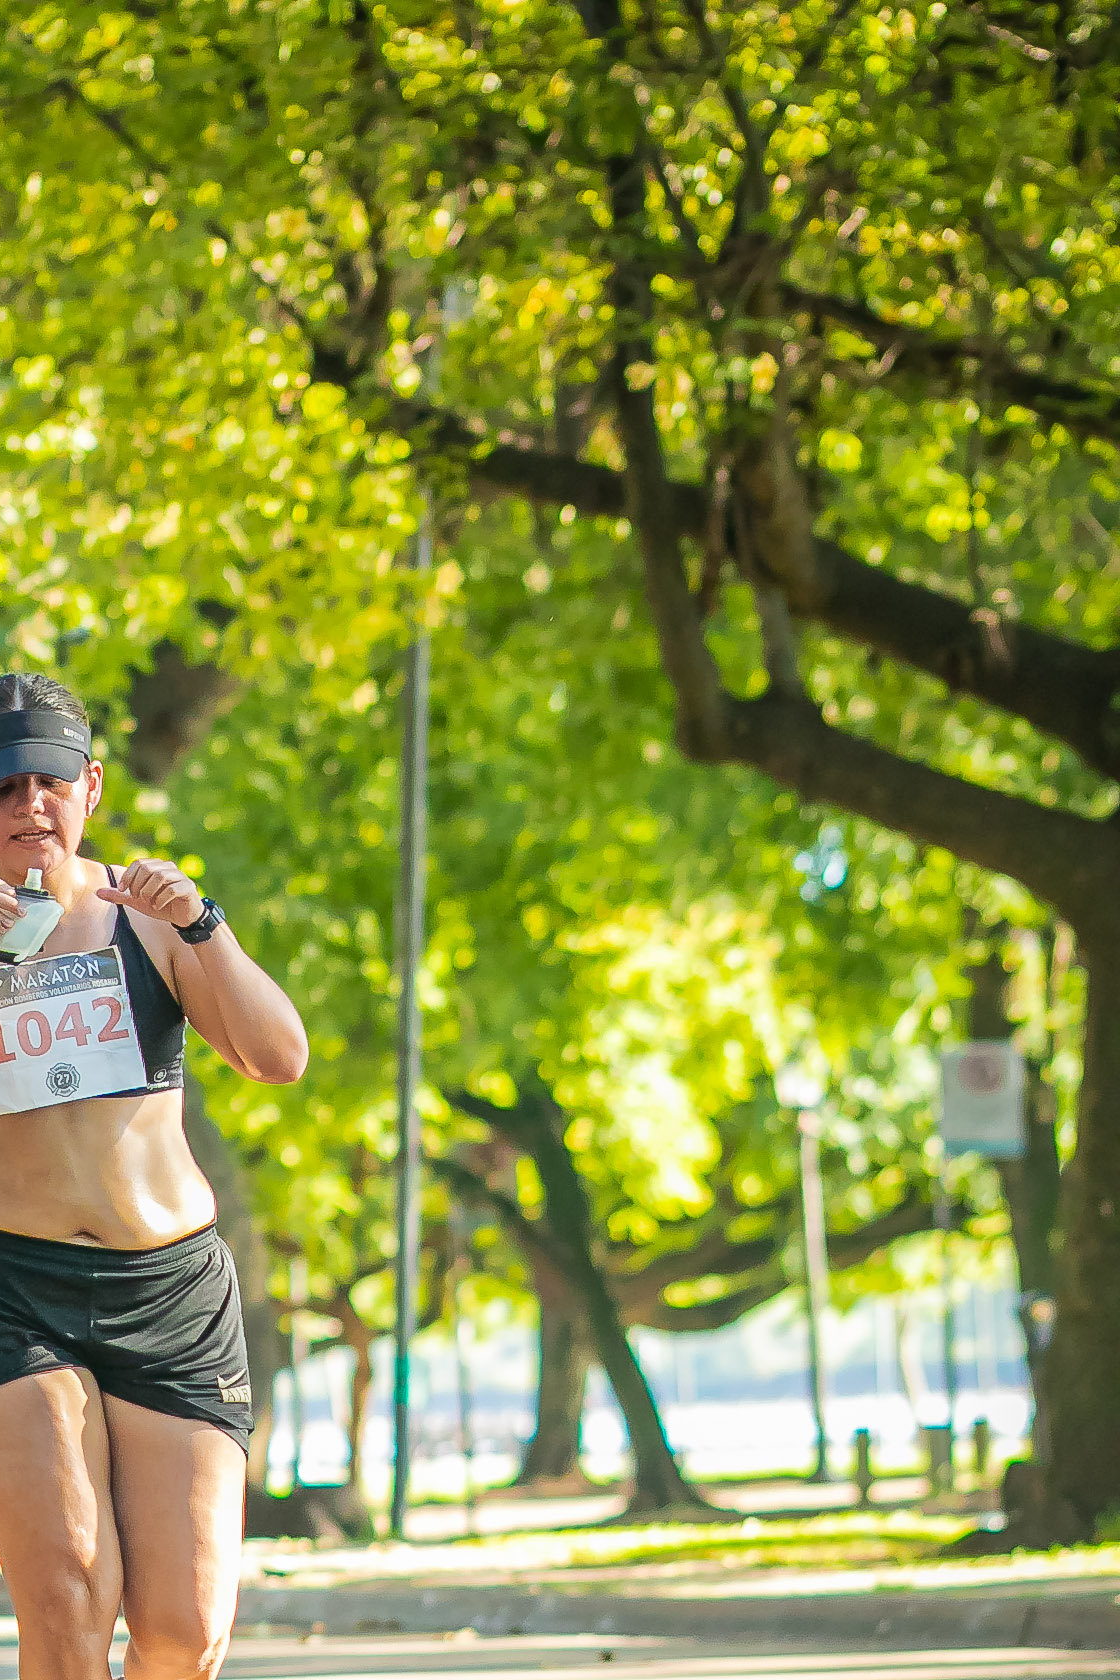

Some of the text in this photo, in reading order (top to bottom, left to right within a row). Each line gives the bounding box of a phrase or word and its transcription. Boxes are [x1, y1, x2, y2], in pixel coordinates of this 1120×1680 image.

[11, 958, 101, 993] MARATÓN
[14, 990, 49, 1004] BOMBEROS
[49, 983, 92, 998] VOLUNTARIOS
[92, 978, 119, 989] ROSARIO
[56, 1073, 70, 1086] 27
[227, 1386, 250, 1402] AIR
